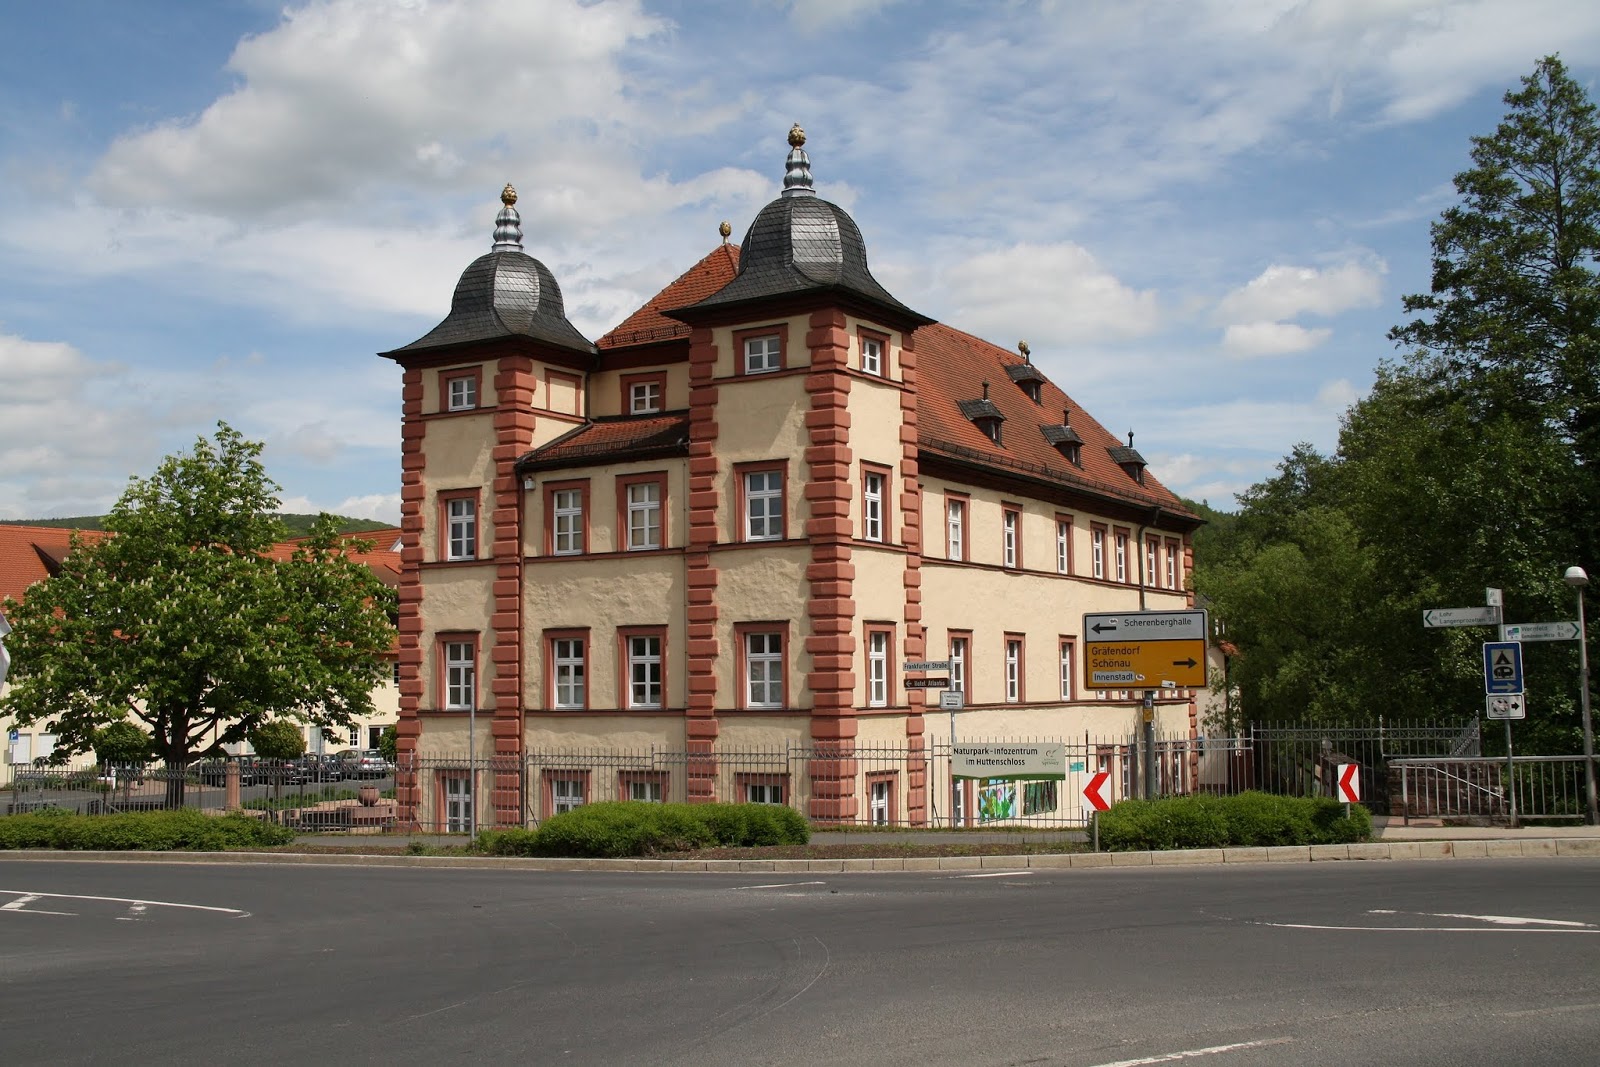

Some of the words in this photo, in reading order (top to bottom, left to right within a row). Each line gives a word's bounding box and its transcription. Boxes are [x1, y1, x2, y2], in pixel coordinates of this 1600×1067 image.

[1124, 618, 1192, 627] Scherenberghalle
[1091, 646, 1141, 656] Gräfendorf
[1092, 658, 1131, 668] Schönau
[1094, 673, 1134, 681] Innenstadt
[953, 747, 1038, 756] Naturpark-Infozentrum
[965, 758, 975, 766] im
[976, 758, 1026, 766] Huttenschloss
